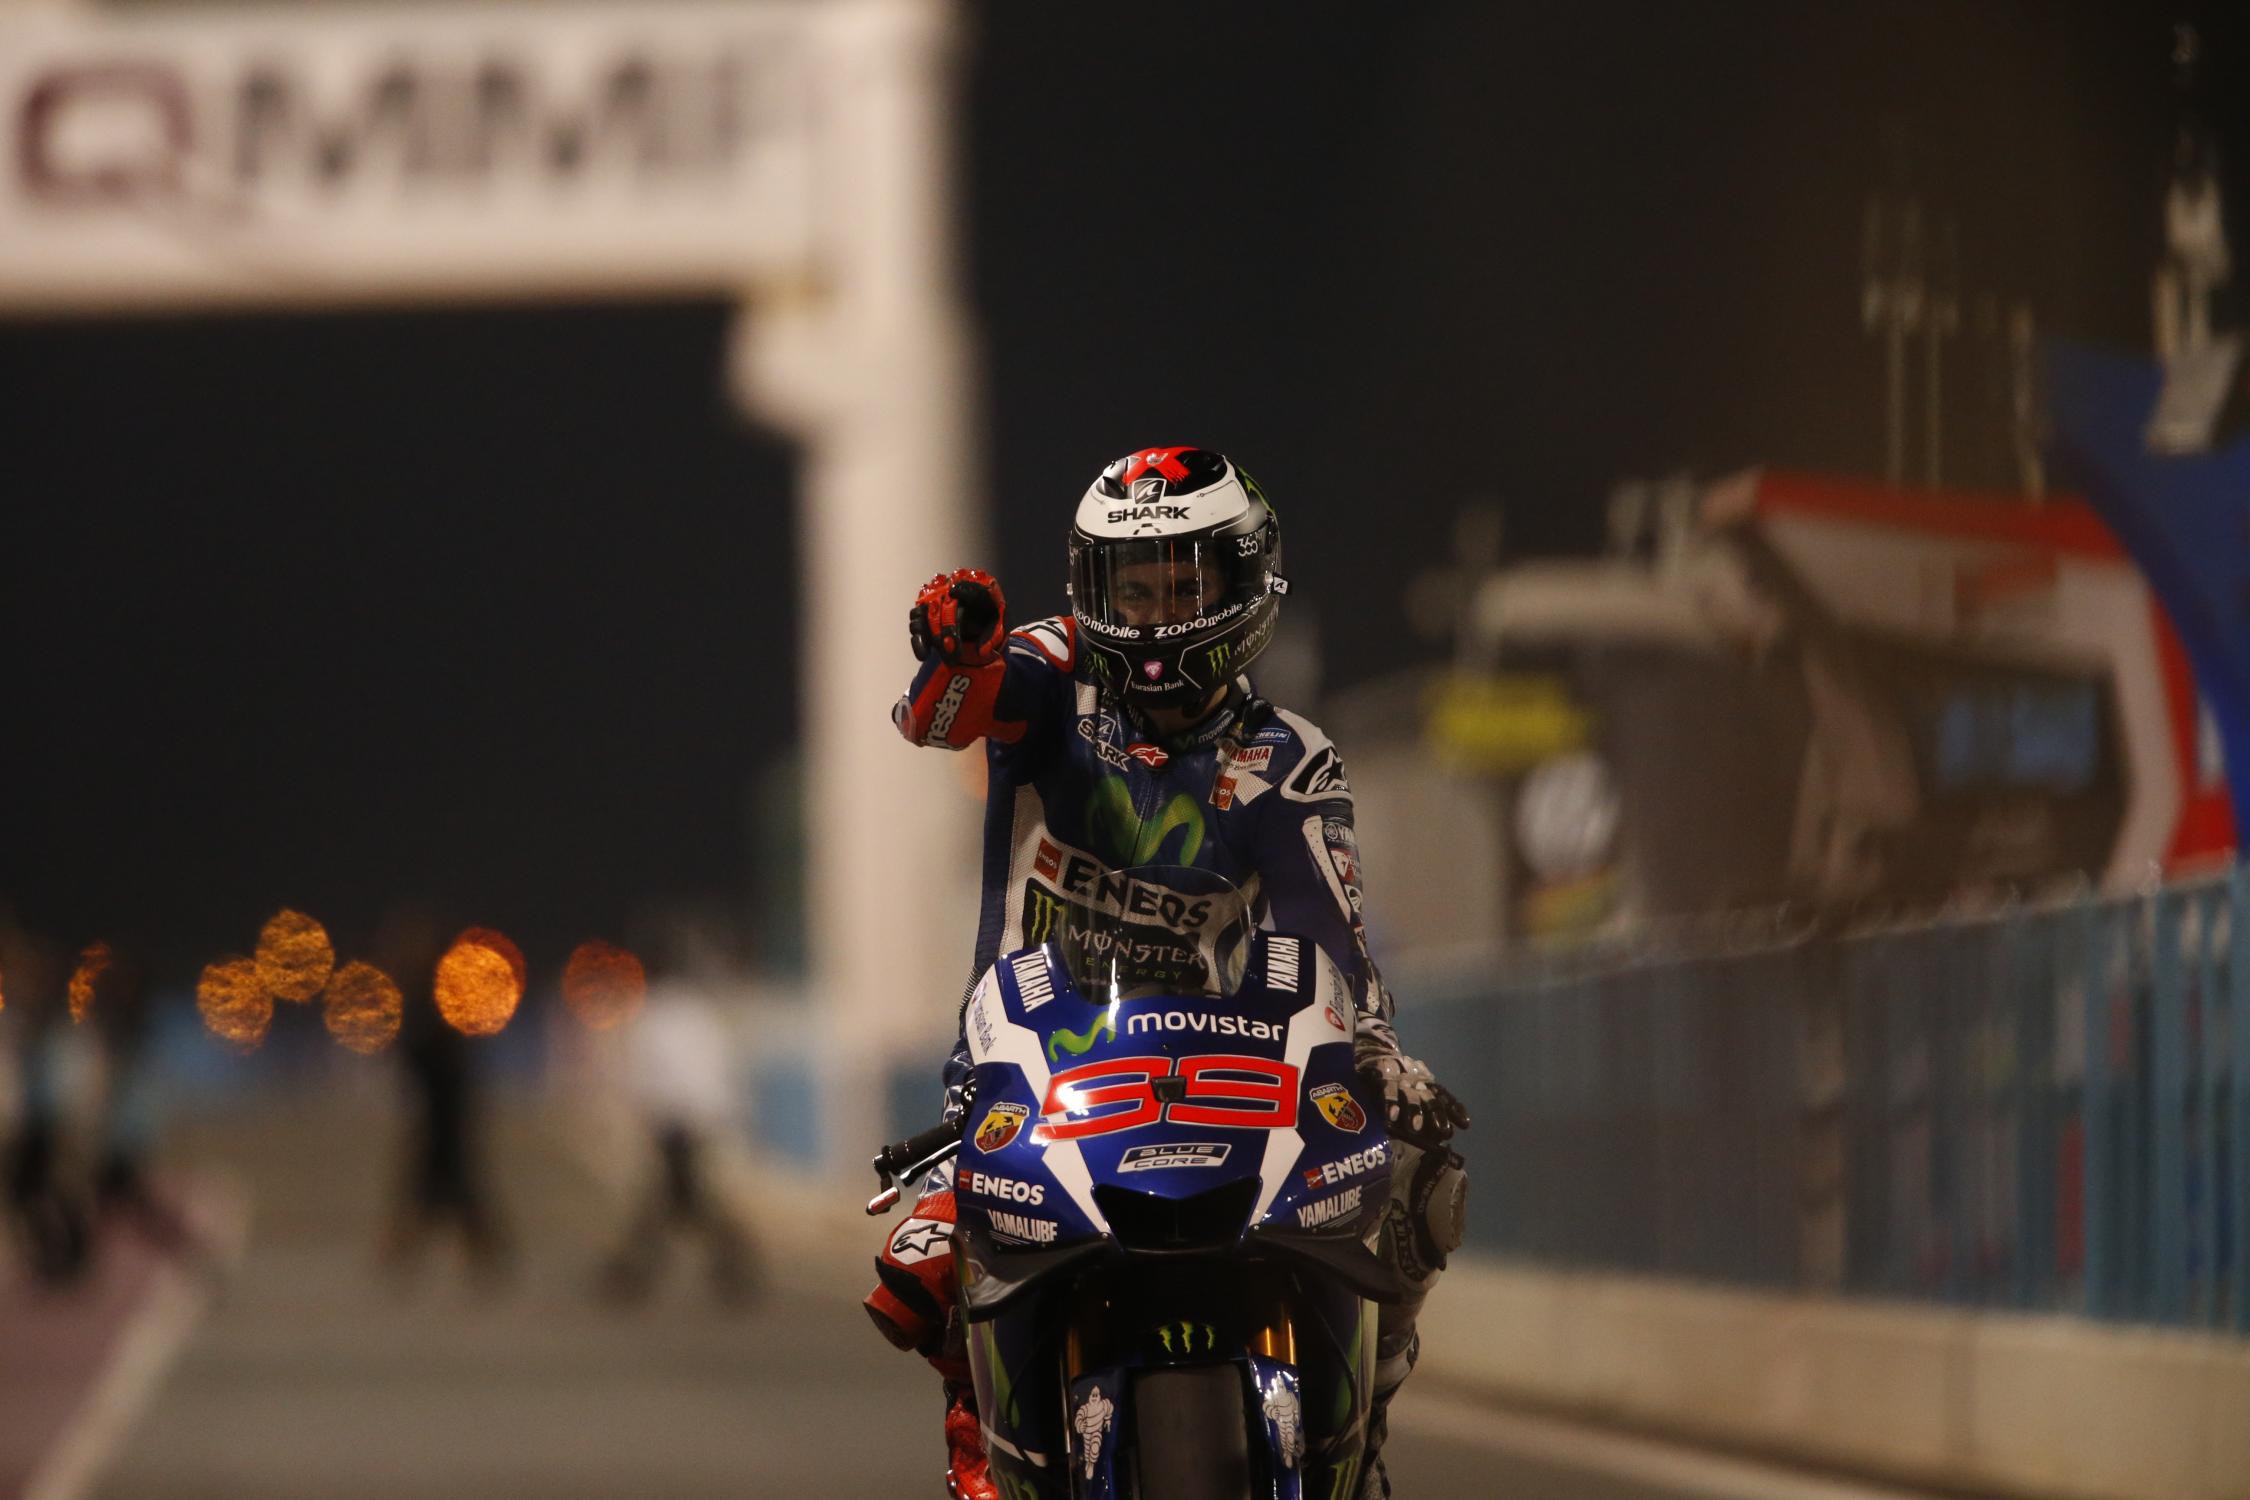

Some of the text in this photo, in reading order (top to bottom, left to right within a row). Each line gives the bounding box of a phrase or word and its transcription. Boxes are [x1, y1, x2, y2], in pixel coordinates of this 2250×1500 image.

[1107, 505, 1191, 524] SHARK
[1163, 679, 1185, 692] Bank
[1063, 855, 1211, 928] ENEOS
[1068, 925, 1208, 971] MONSTER
[1267, 936, 1300, 993] YAMAHA
[1011, 952, 1055, 1013] YAMAHA
[1127, 1011, 1284, 1041] movistar
[1029, 1054, 1301, 1146] 99
[1134, 1156, 1208, 1168] CORE
[1139, 1145, 1215, 1156] BLUE
[1321, 1147, 1386, 1185] ENEOS
[971, 1172, 1045, 1206] ENEOS
[1297, 1186, 1363, 1229] YAMALUBE
